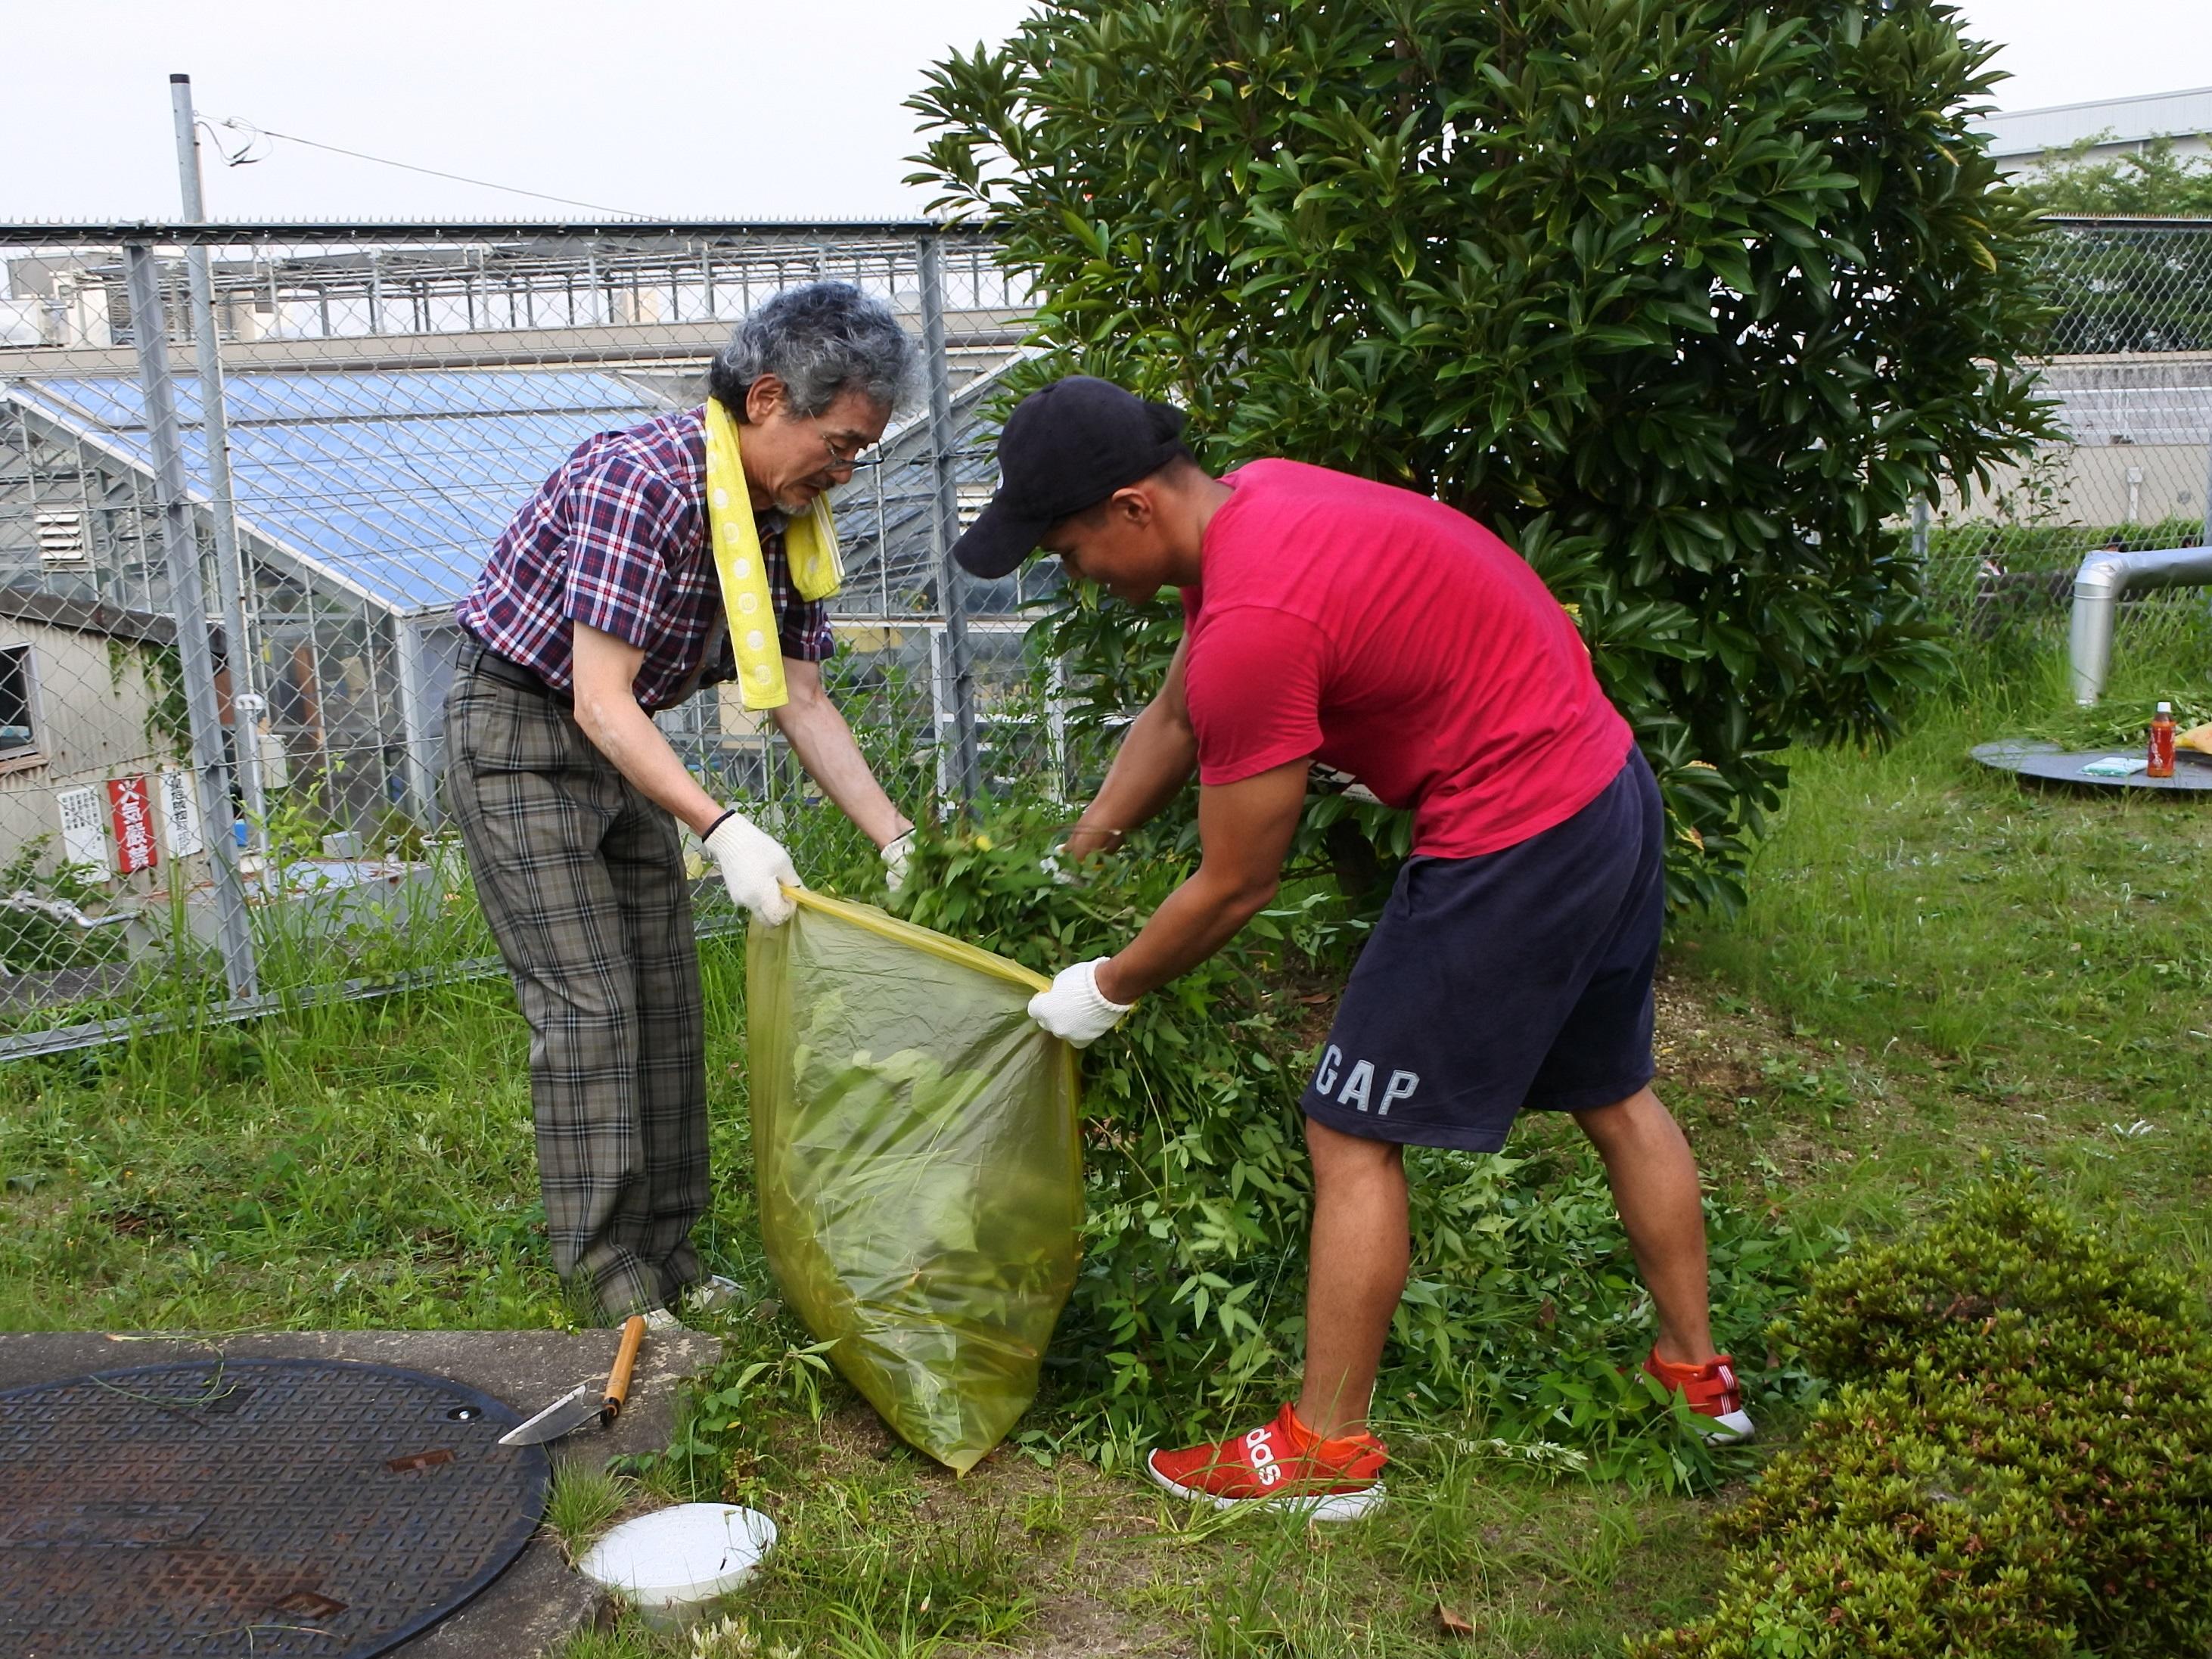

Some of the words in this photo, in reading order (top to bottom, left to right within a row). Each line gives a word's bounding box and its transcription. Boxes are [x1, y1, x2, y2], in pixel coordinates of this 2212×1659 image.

[118, 780, 149, 868] 火気厳禁
[1316, 1044, 1420, 1116] GAP
